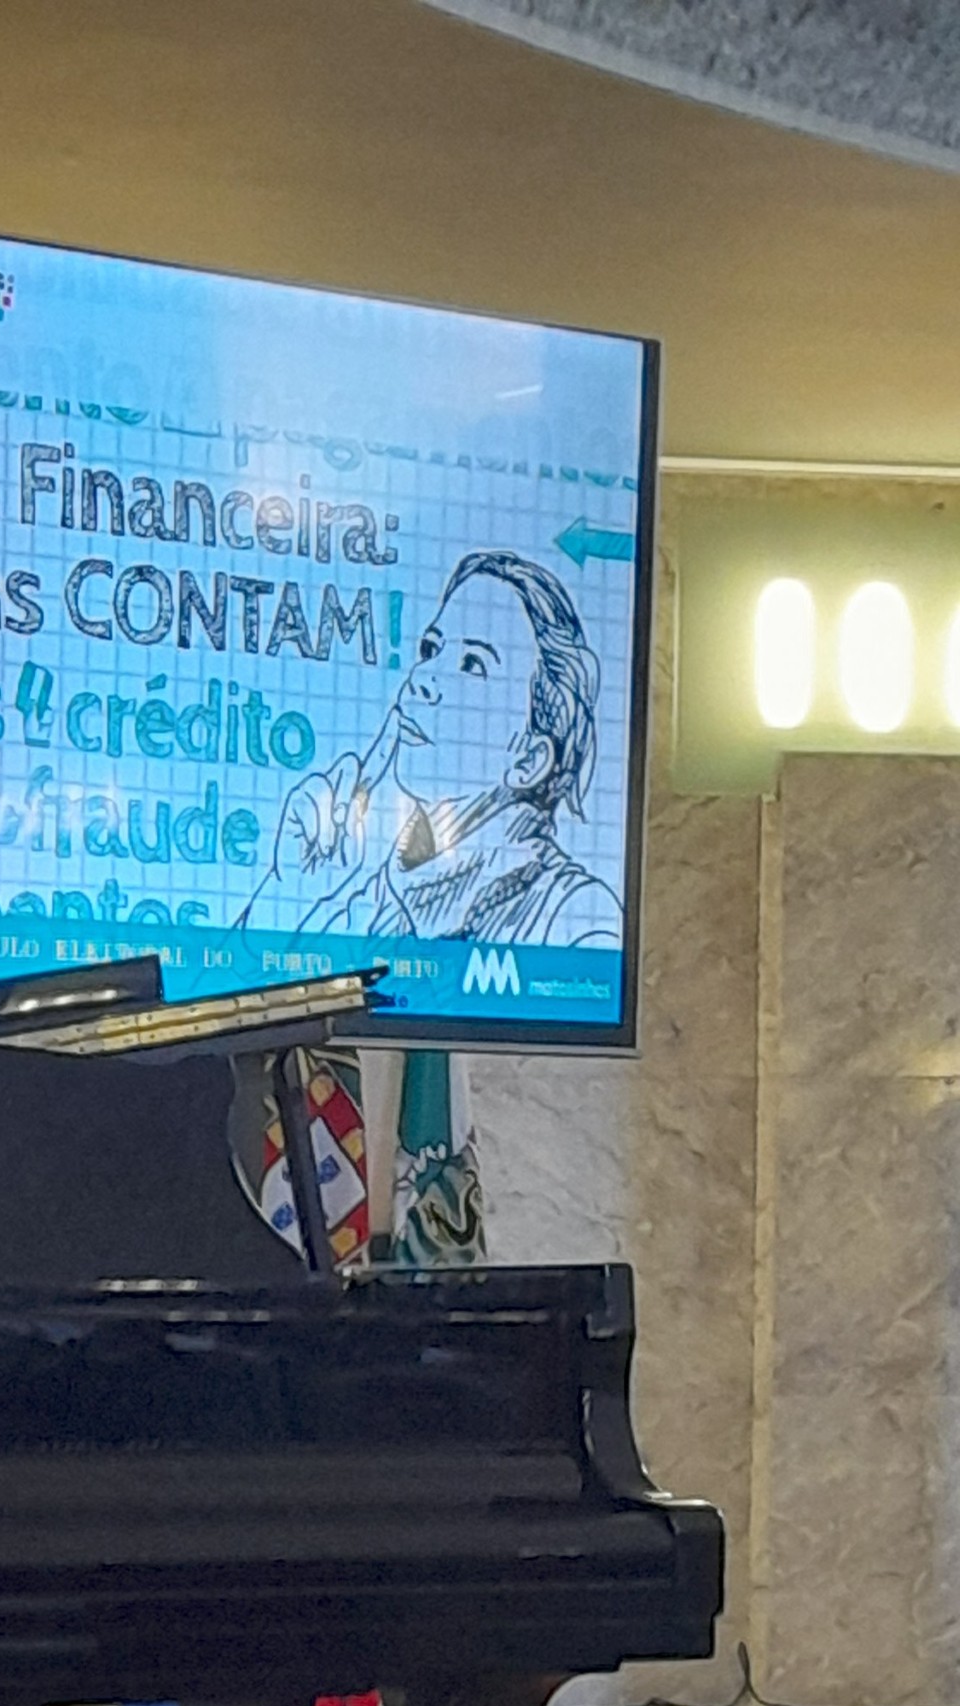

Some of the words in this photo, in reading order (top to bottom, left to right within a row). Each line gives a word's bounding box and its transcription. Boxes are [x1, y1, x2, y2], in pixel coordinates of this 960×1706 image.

[20, 441, 400, 566] Financeira:
[64, 557, 404, 670] CONTAM!
[66, 673, 316, 770] crédito
[25, 764, 261, 867] fraude
